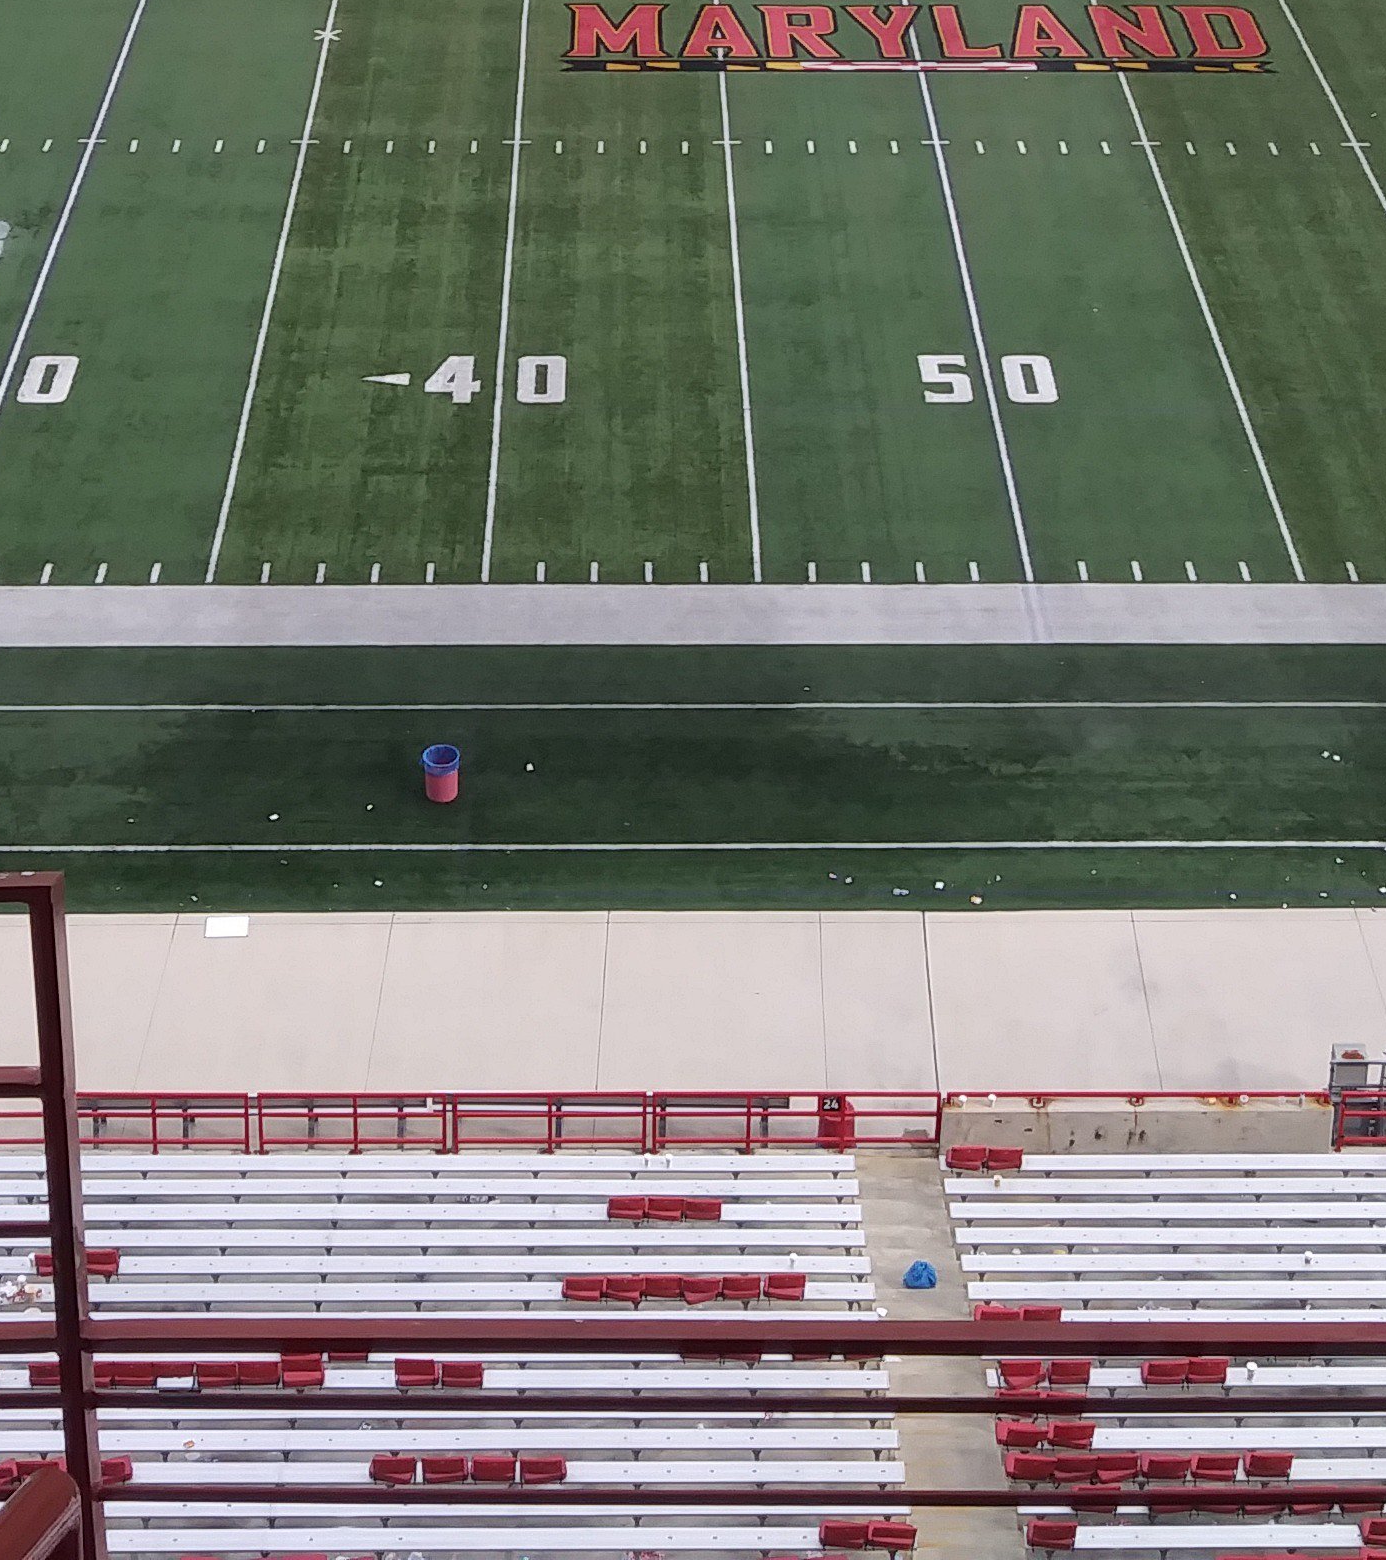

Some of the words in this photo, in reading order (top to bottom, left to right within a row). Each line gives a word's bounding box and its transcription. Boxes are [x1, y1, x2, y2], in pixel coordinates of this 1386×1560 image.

[563, 2, 1273, 61] MARYLAND
[423, 355, 566, 405] 40
[916, 354, 1060, 404] 50
[822, 1098, 839, 1111] 24
